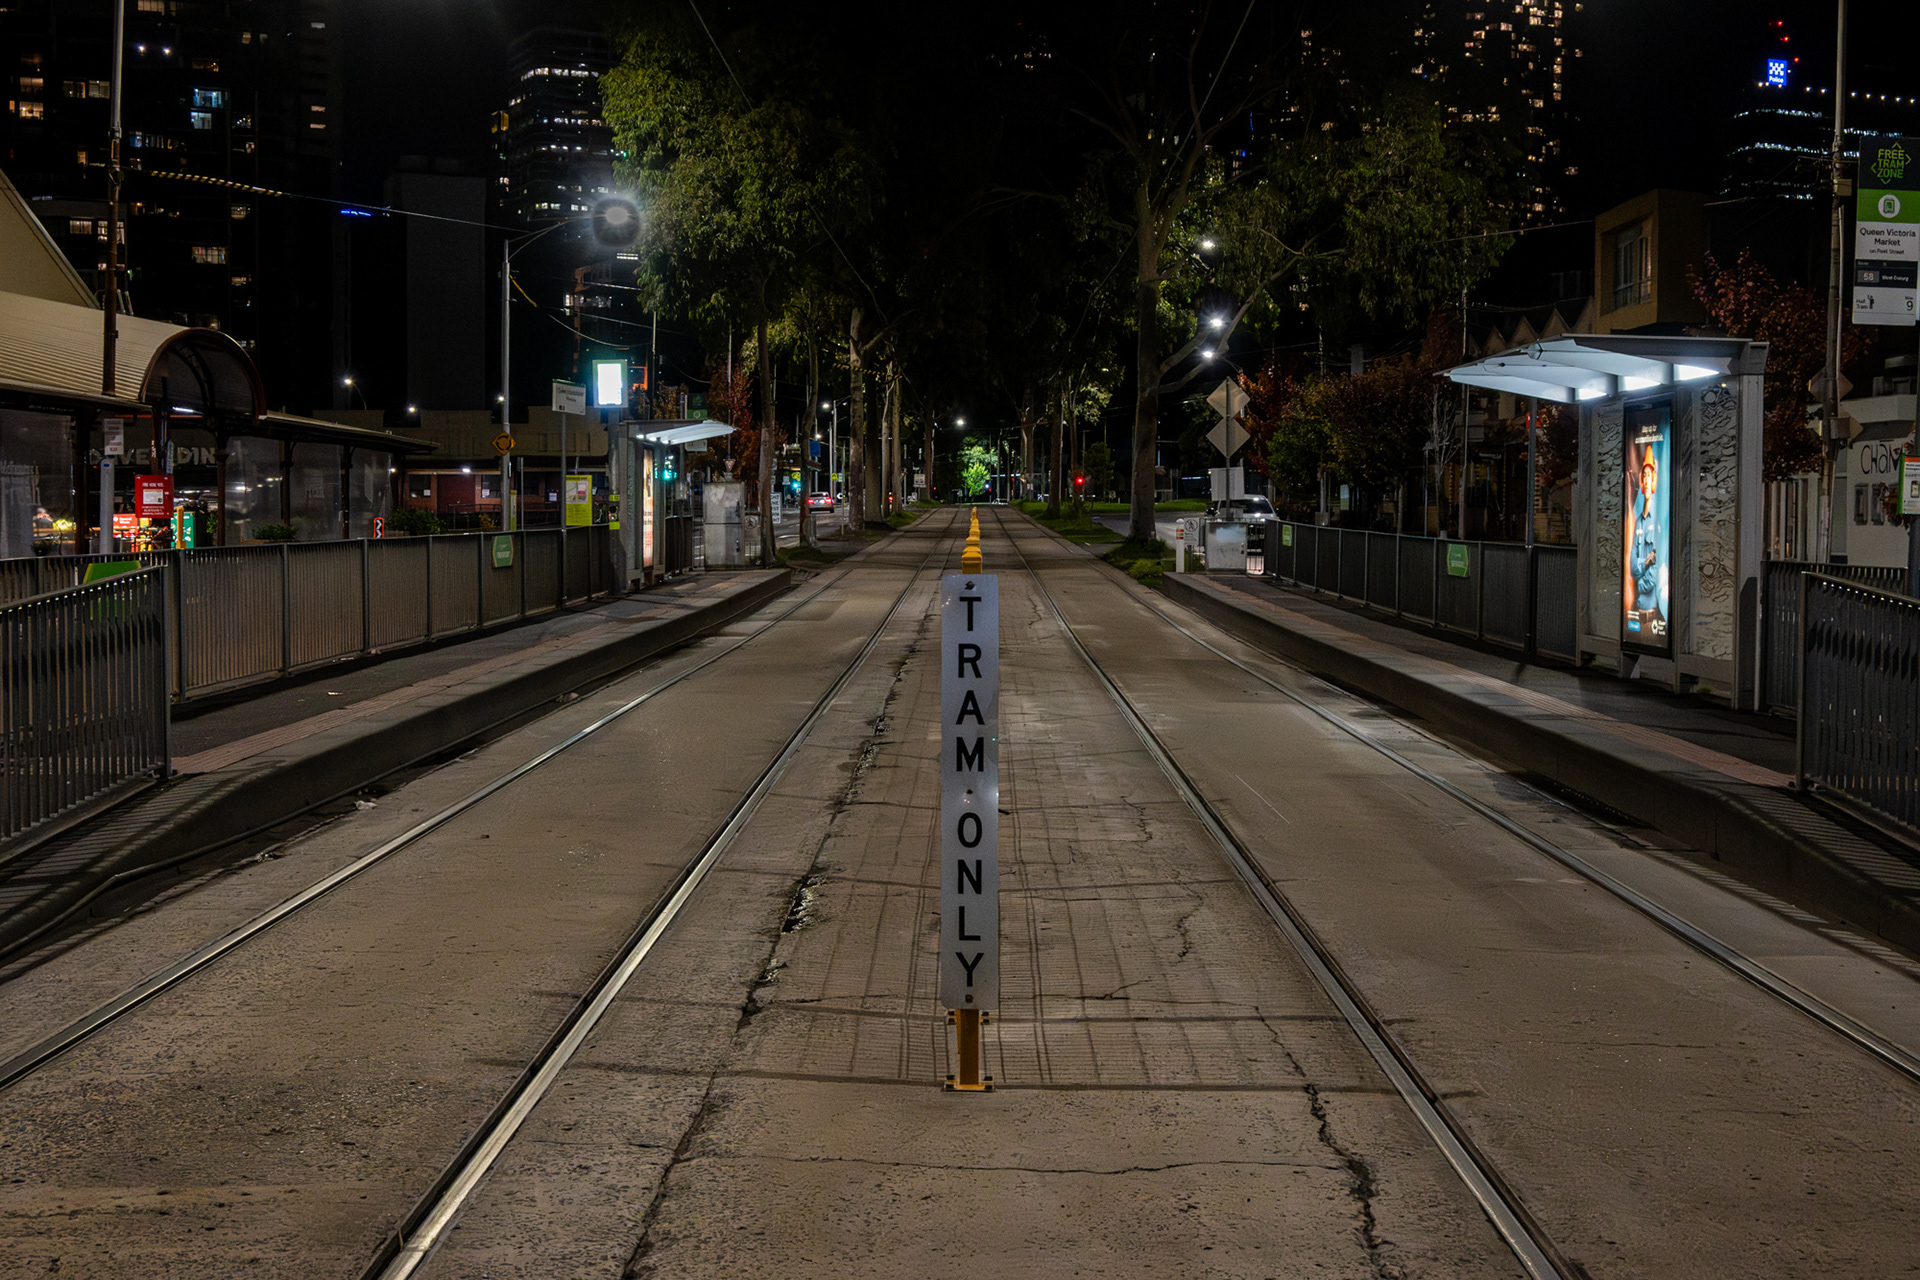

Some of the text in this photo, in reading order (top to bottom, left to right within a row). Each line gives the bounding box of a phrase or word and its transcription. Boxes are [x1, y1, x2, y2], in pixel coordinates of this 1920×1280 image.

[1878, 149, 1905, 160] FREE
[1877, 159, 1905, 169] TRAM
[1877, 168, 1904, 179] ZONE
[1860, 227, 1916, 237] Queen Victoria
[1874, 238, 1901, 246] Market
[1906, 300, 1914, 311] 9
[955, 596, 985, 987] TRAM ONLY
